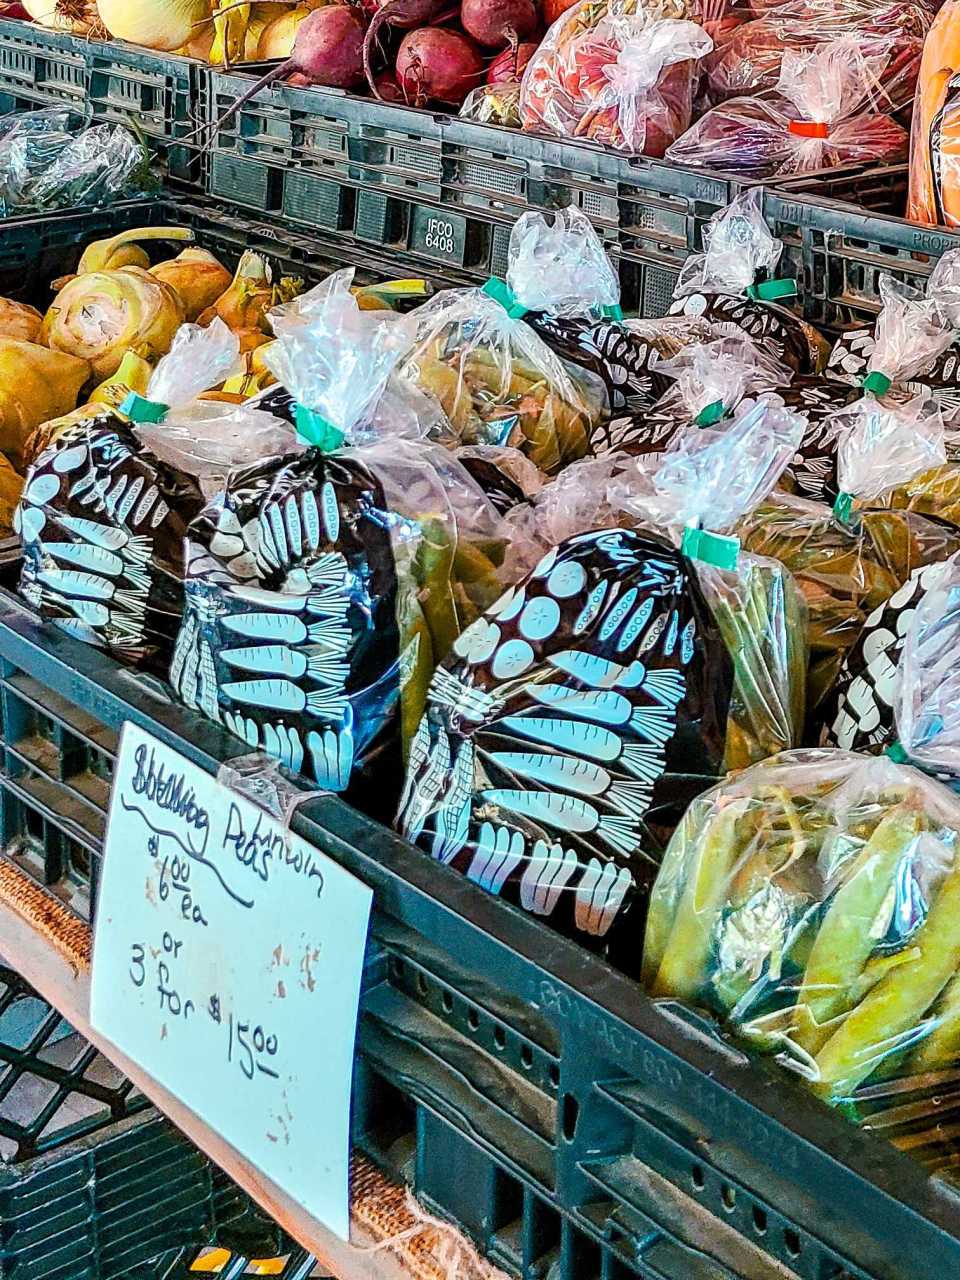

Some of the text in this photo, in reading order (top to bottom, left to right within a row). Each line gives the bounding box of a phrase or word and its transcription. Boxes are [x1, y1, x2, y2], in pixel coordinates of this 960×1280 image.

[425, 232, 454, 253] 6408
[427, 218, 454, 238] IFCO
[180, 893, 208, 926] ea
[162, 930, 183, 959] or
[129, 942, 146, 987] 3
[157, 960, 195, 1020] for
